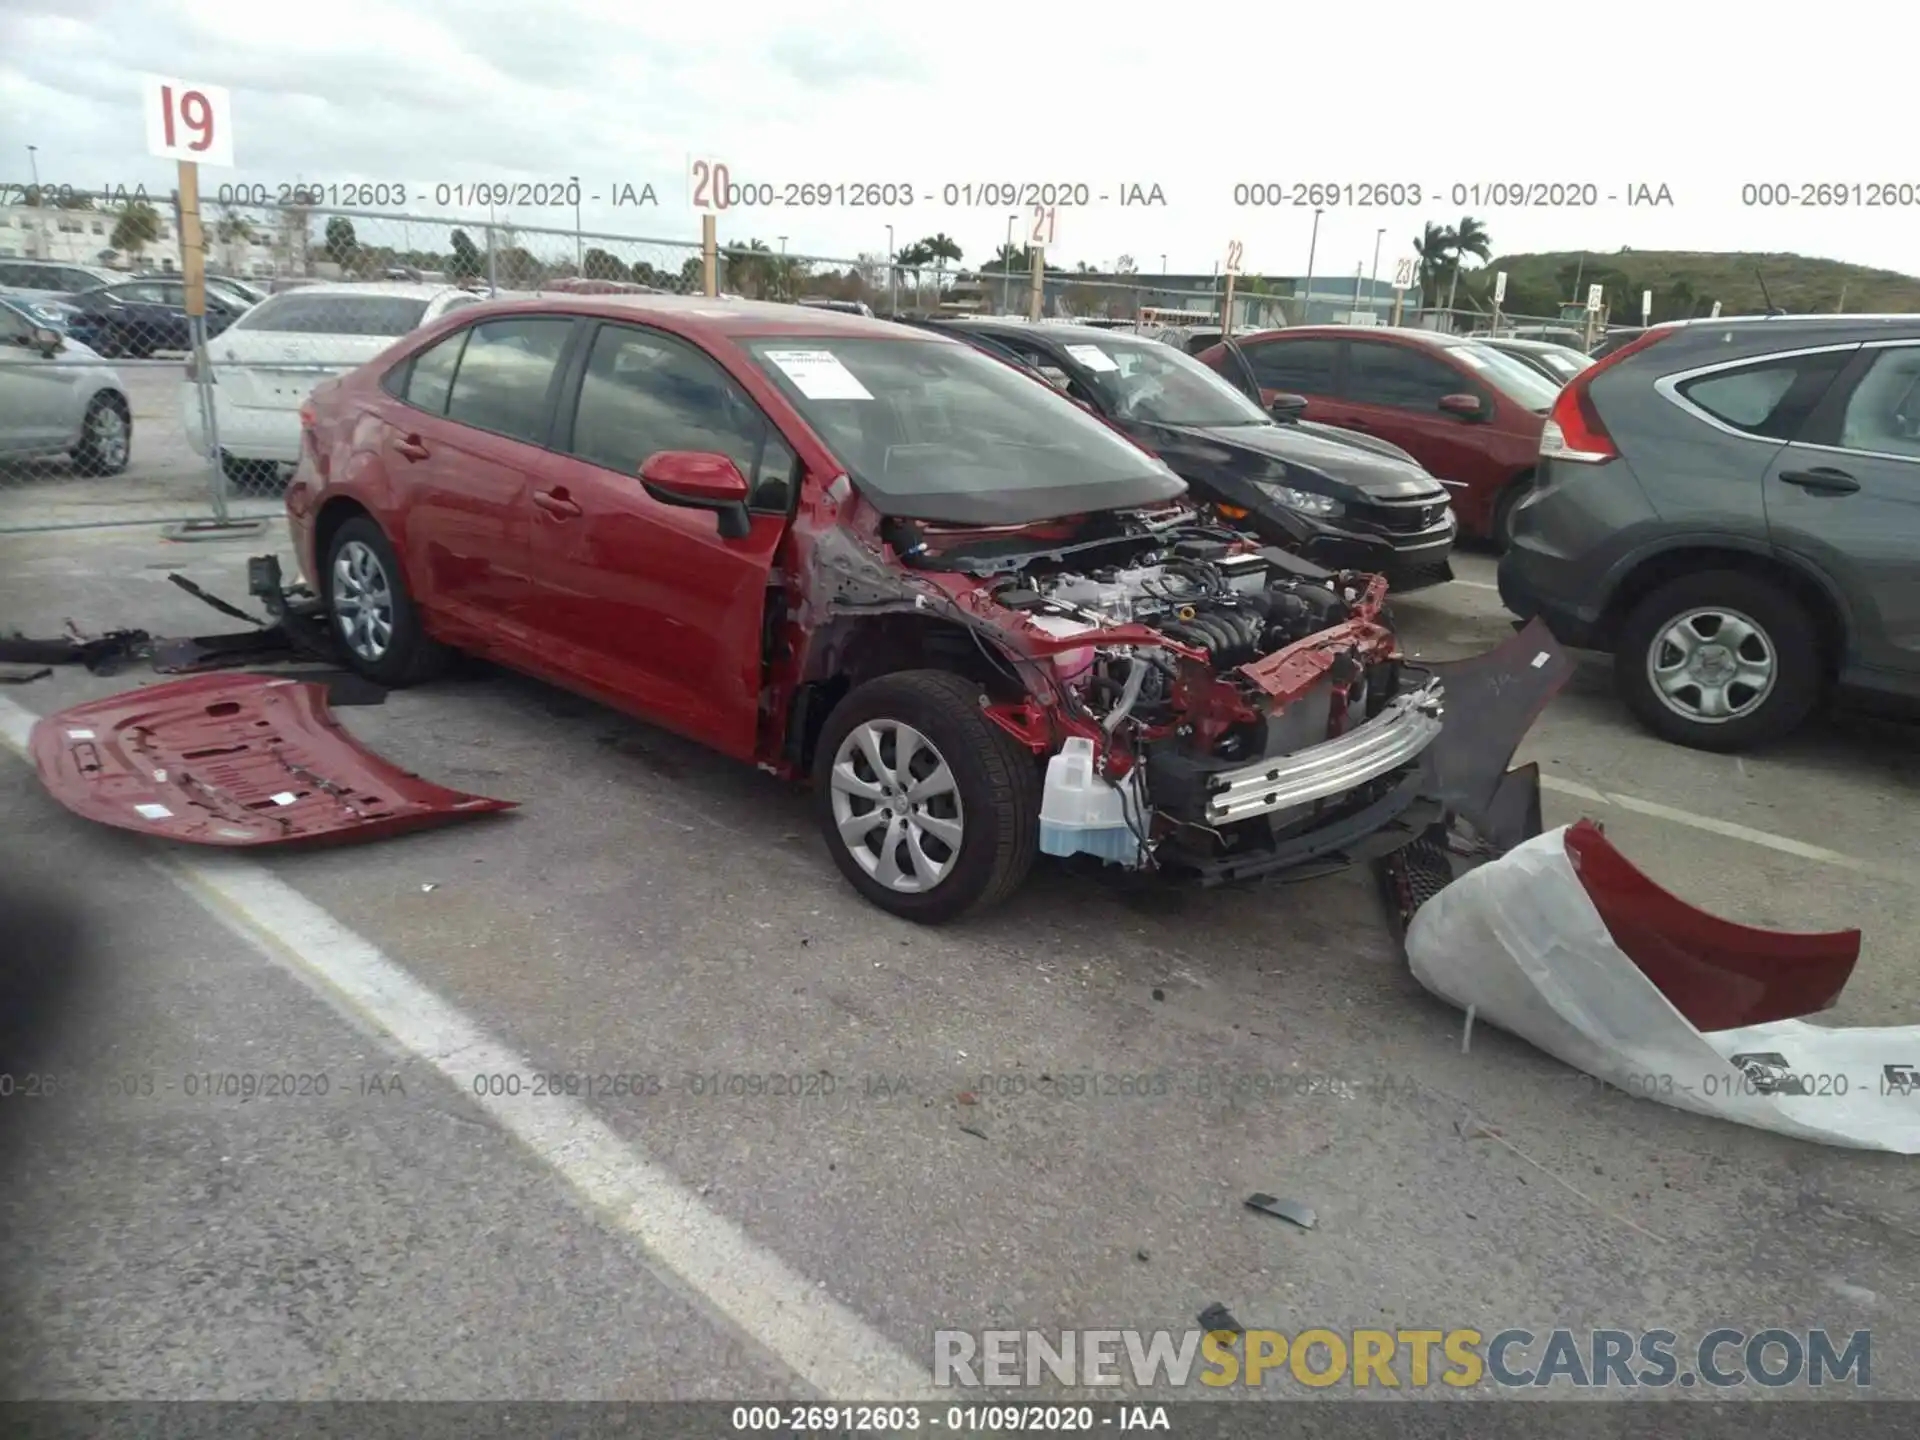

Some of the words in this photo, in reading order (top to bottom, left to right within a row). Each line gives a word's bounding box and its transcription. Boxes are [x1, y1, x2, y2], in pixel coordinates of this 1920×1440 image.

[161, 85, 214, 151] 19
[693, 160, 729, 210] 20
[1033, 205, 1055, 243] 21
